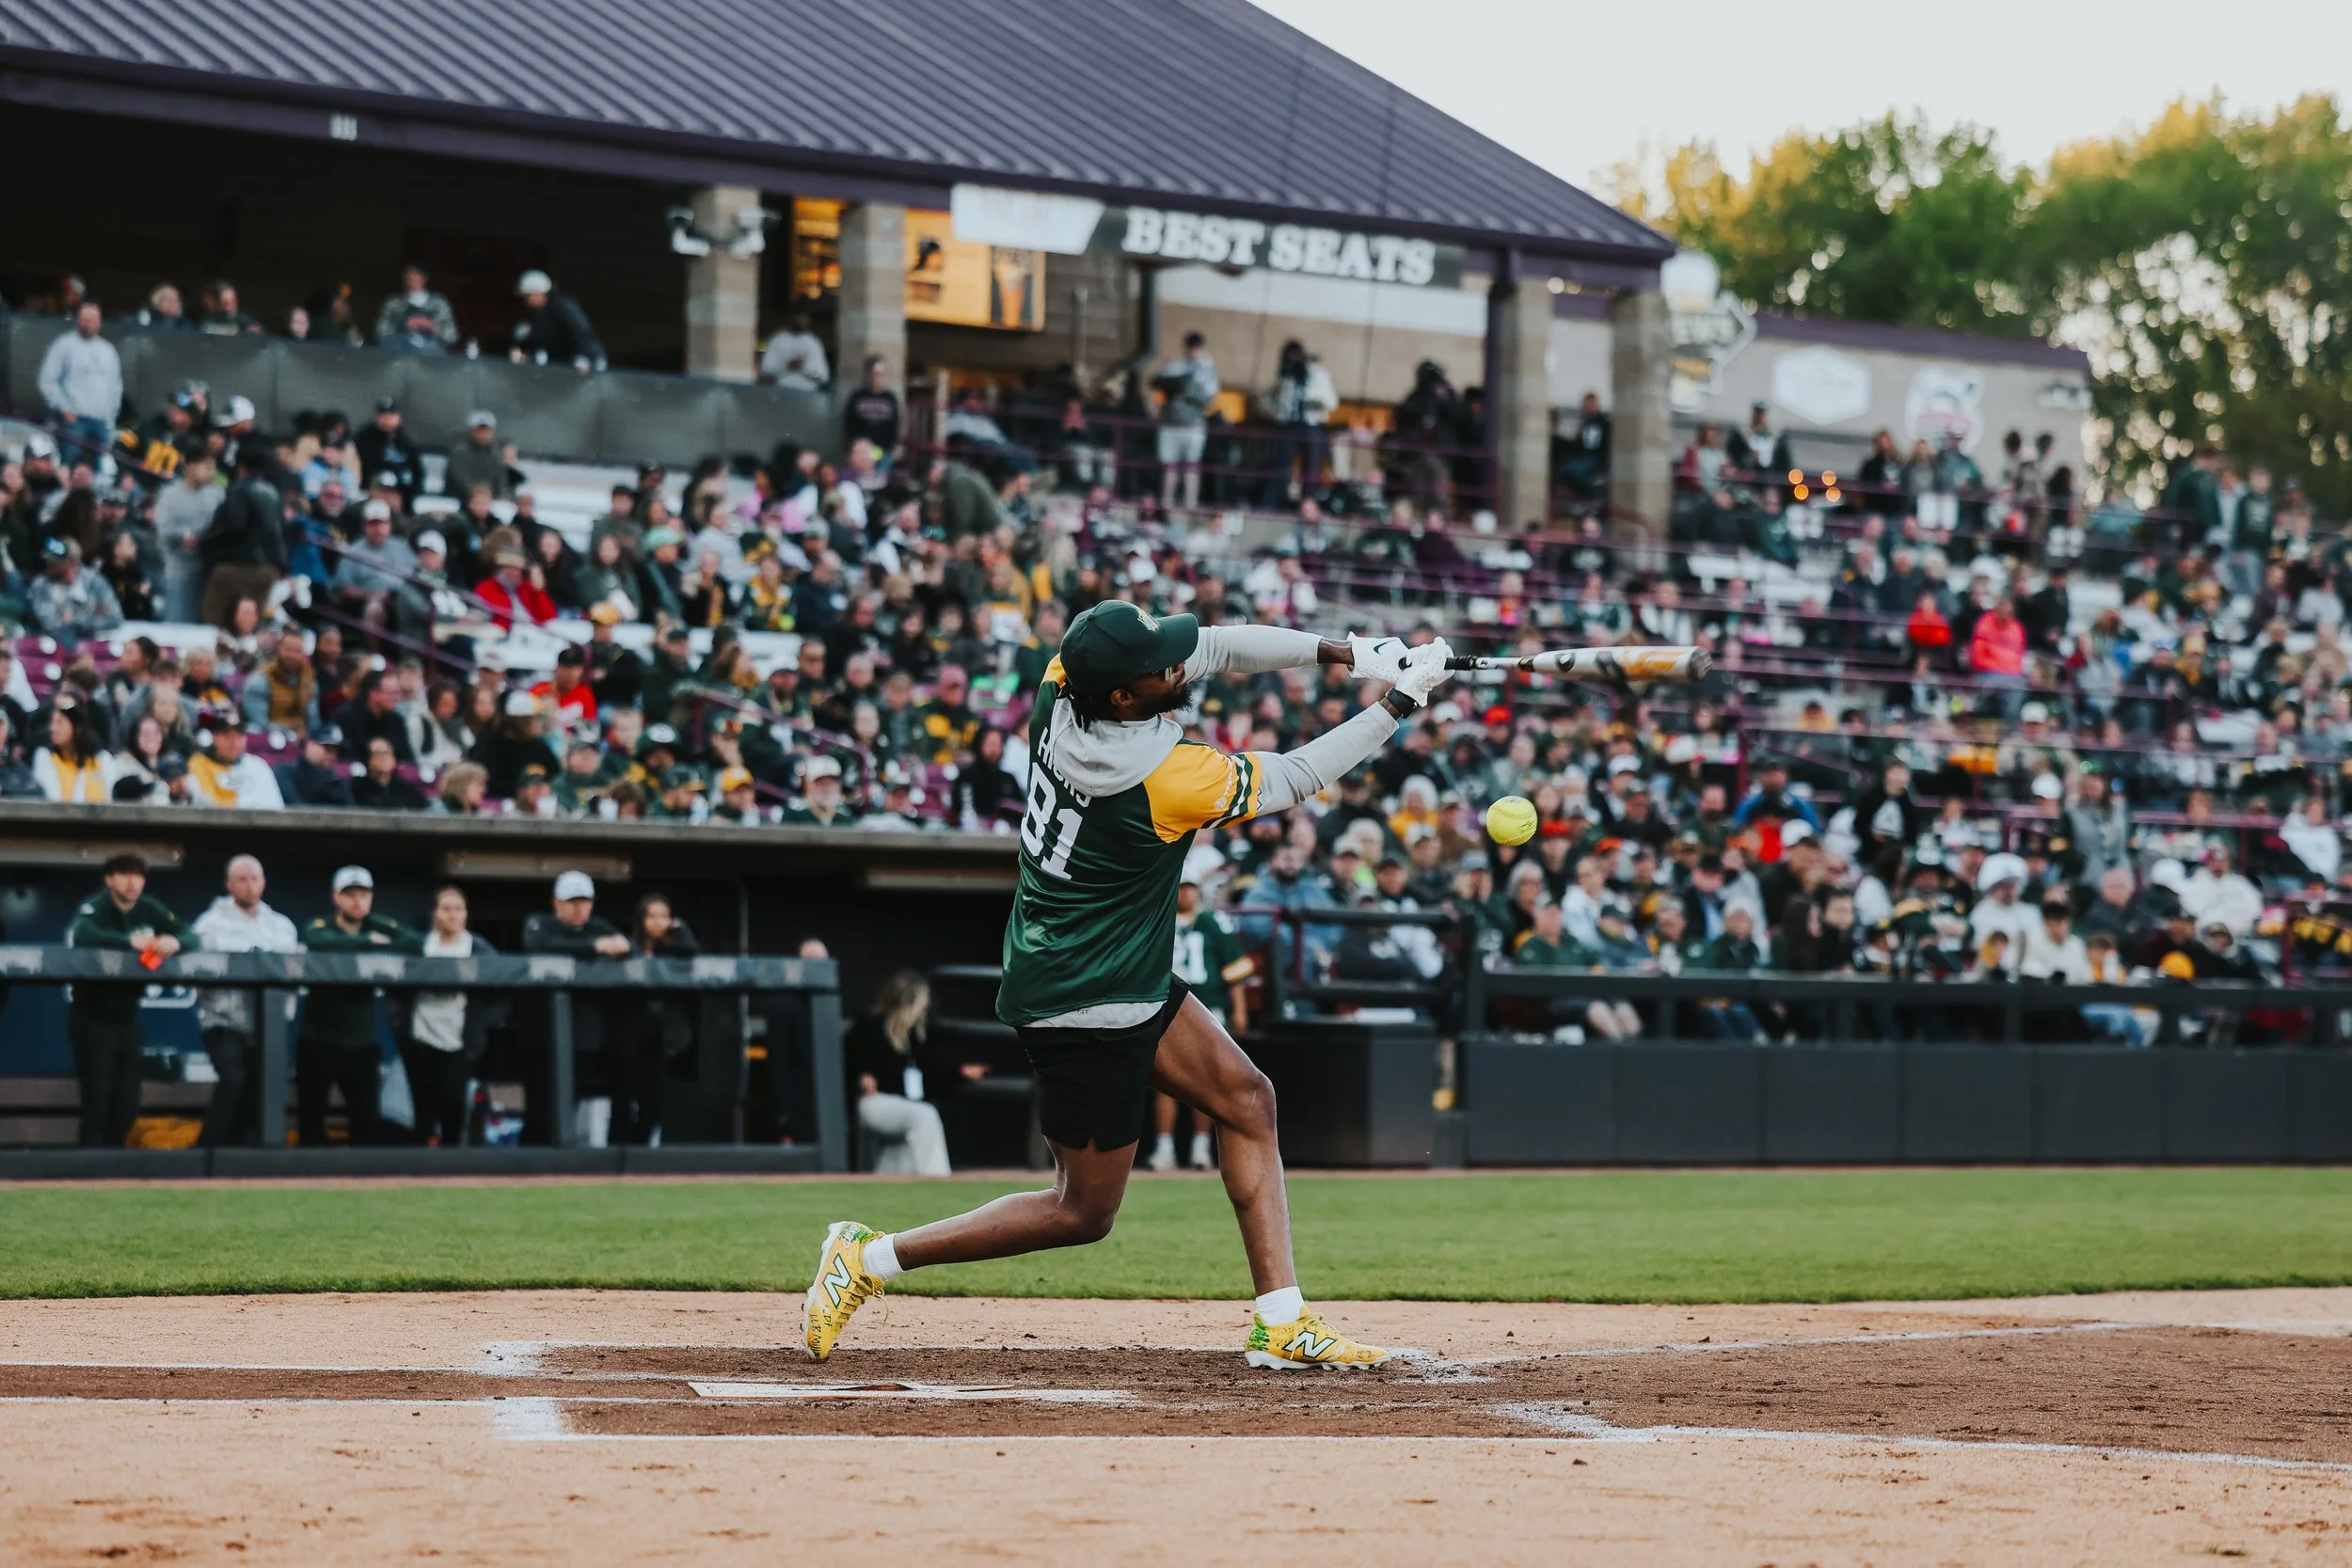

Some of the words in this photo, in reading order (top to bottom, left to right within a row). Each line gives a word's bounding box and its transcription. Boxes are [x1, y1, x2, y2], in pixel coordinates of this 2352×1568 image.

[1120, 206, 1265, 267] BEST
[1267, 222, 1437, 285] SEATS
[1021, 762, 1083, 879] 81
